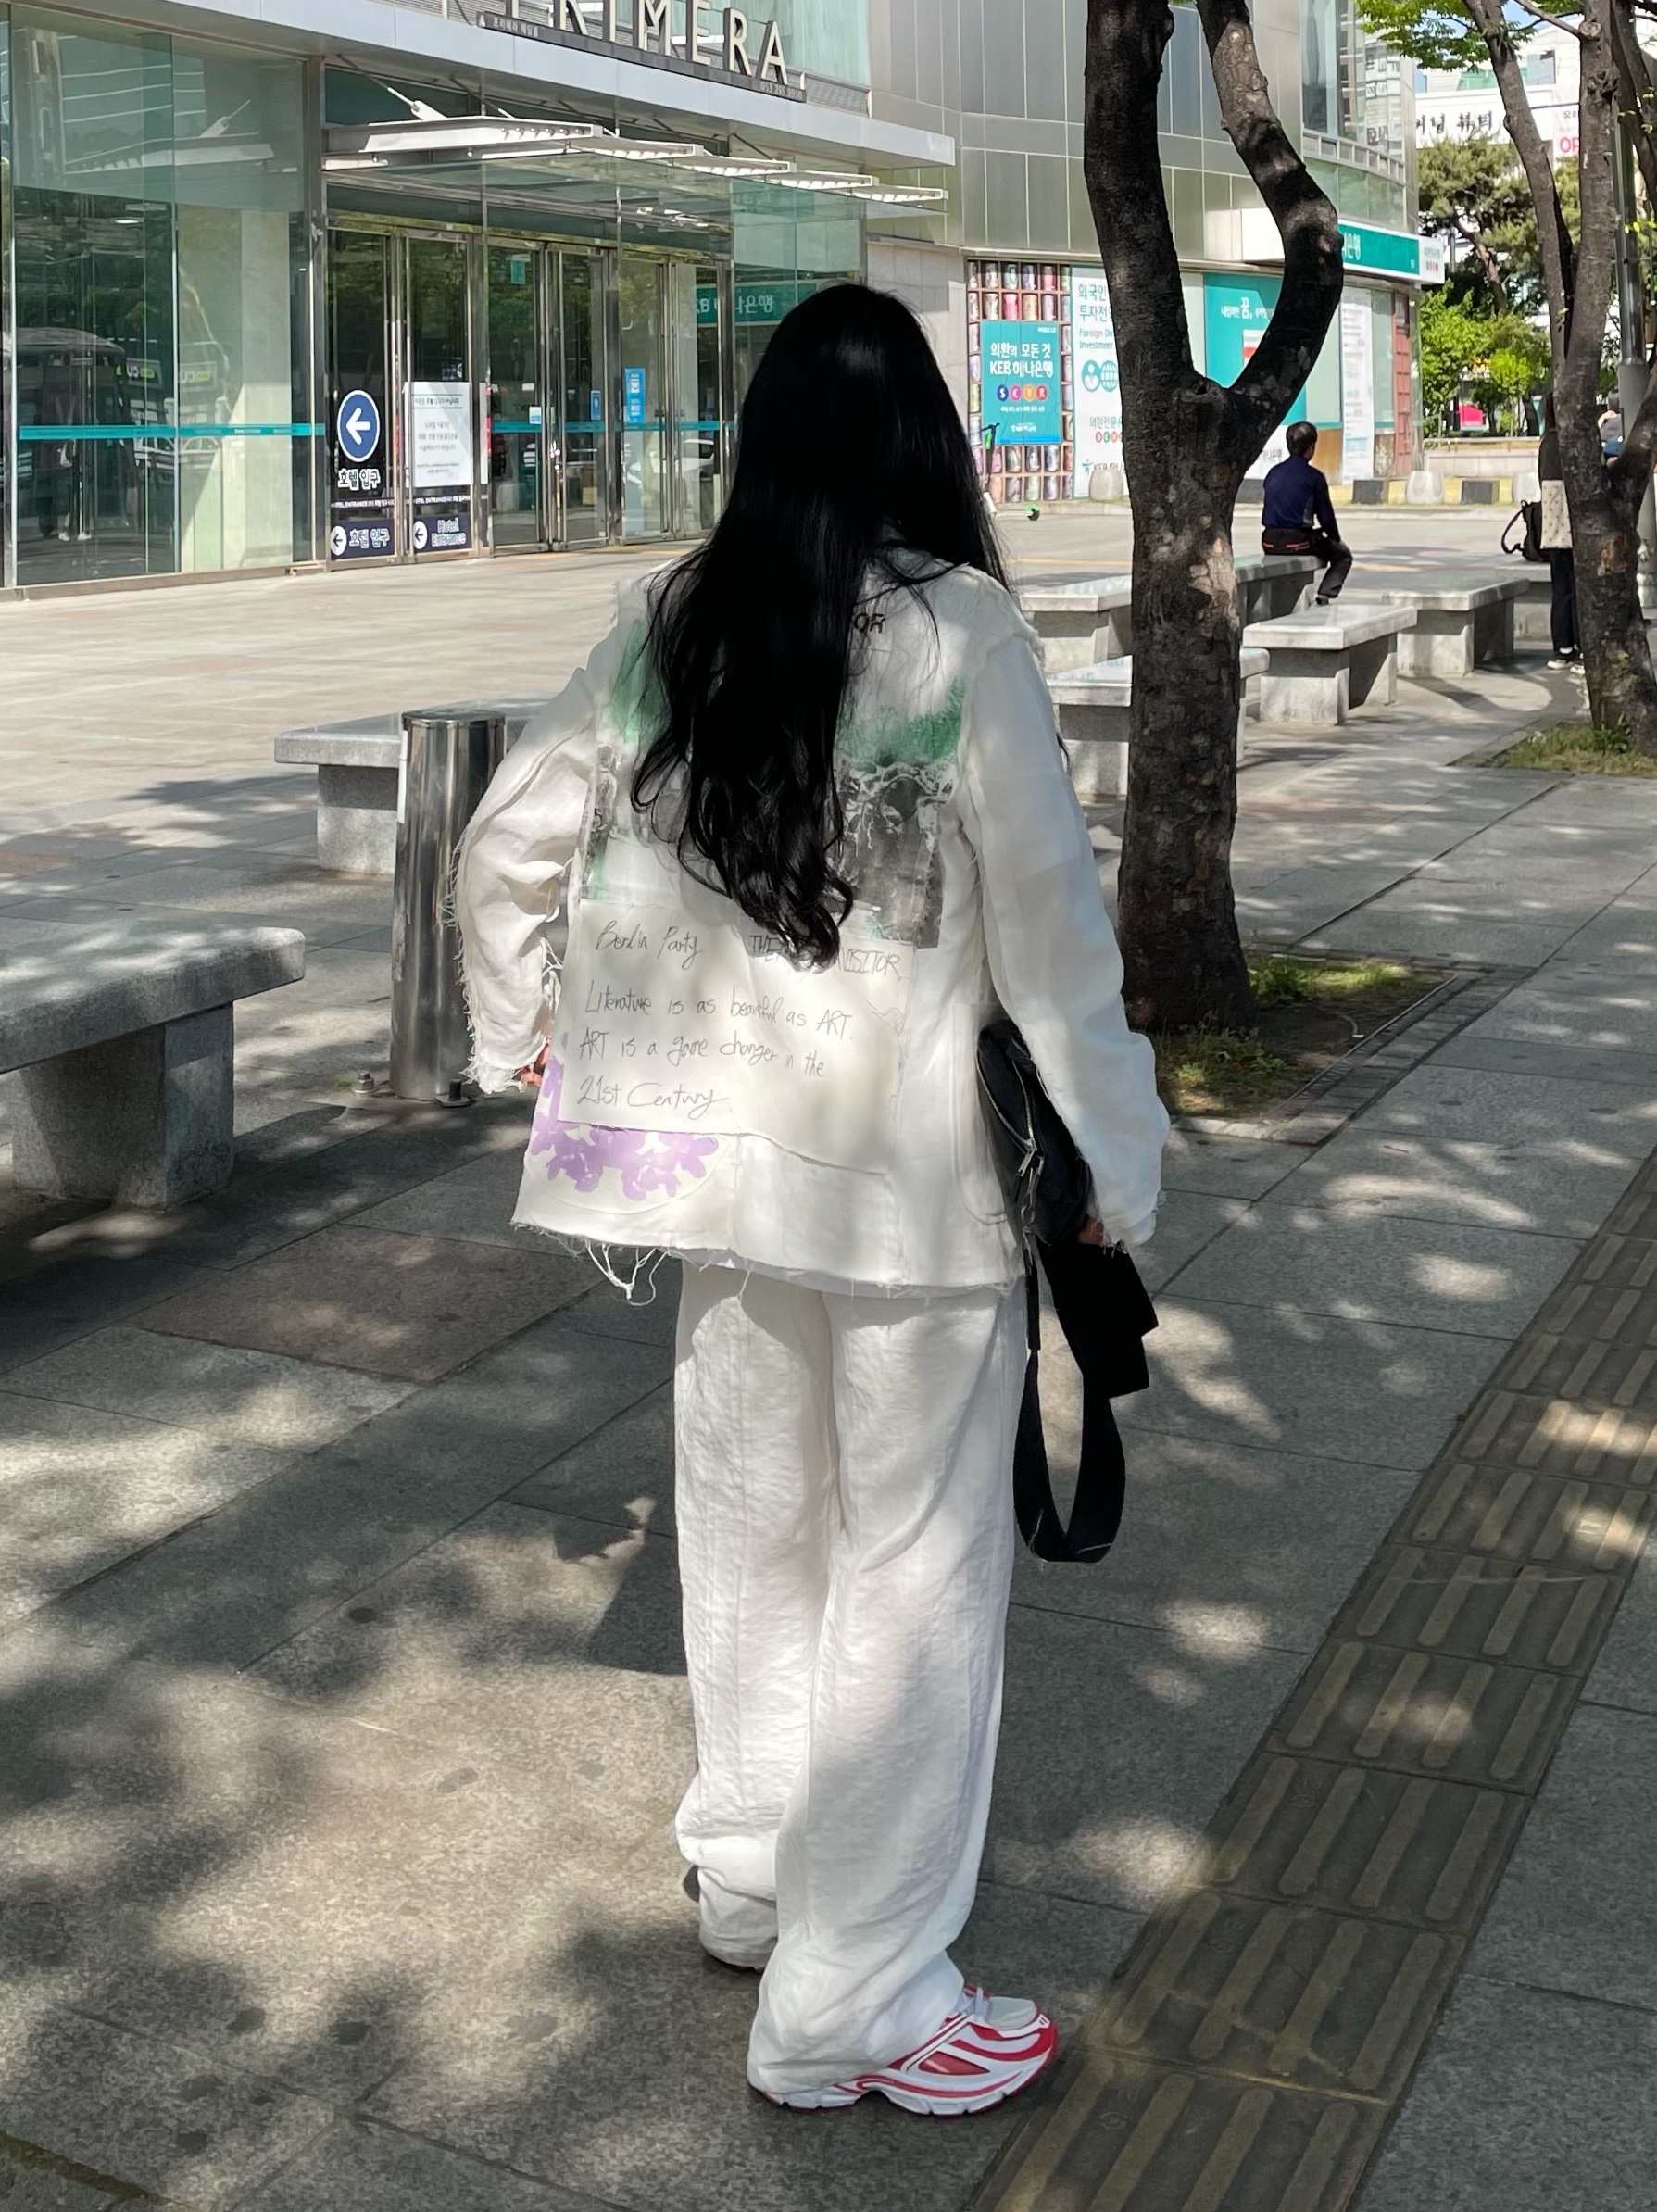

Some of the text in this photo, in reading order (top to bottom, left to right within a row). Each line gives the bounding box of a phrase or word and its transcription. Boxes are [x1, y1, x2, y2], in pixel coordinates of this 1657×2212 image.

[506, 0, 787, 86] IMERA
[1078, 284, 1106, 302] 외국인
[1021, 343, 1040, 359] 모든
[989, 360, 1011, 376] KEB
[338, 468, 381, 490] 호텔 입구
[349, 528, 390, 548] 호텔 입구
[595, 920, 703, 970] Berlin Party
[668, 999, 684, 1015] is
[697, 999, 716, 1014] as
[787, 1010, 807, 1026] as
[579, 1026, 824, 1077] ART is a game changer in the
[577, 1075, 730, 1121] 21st Century
